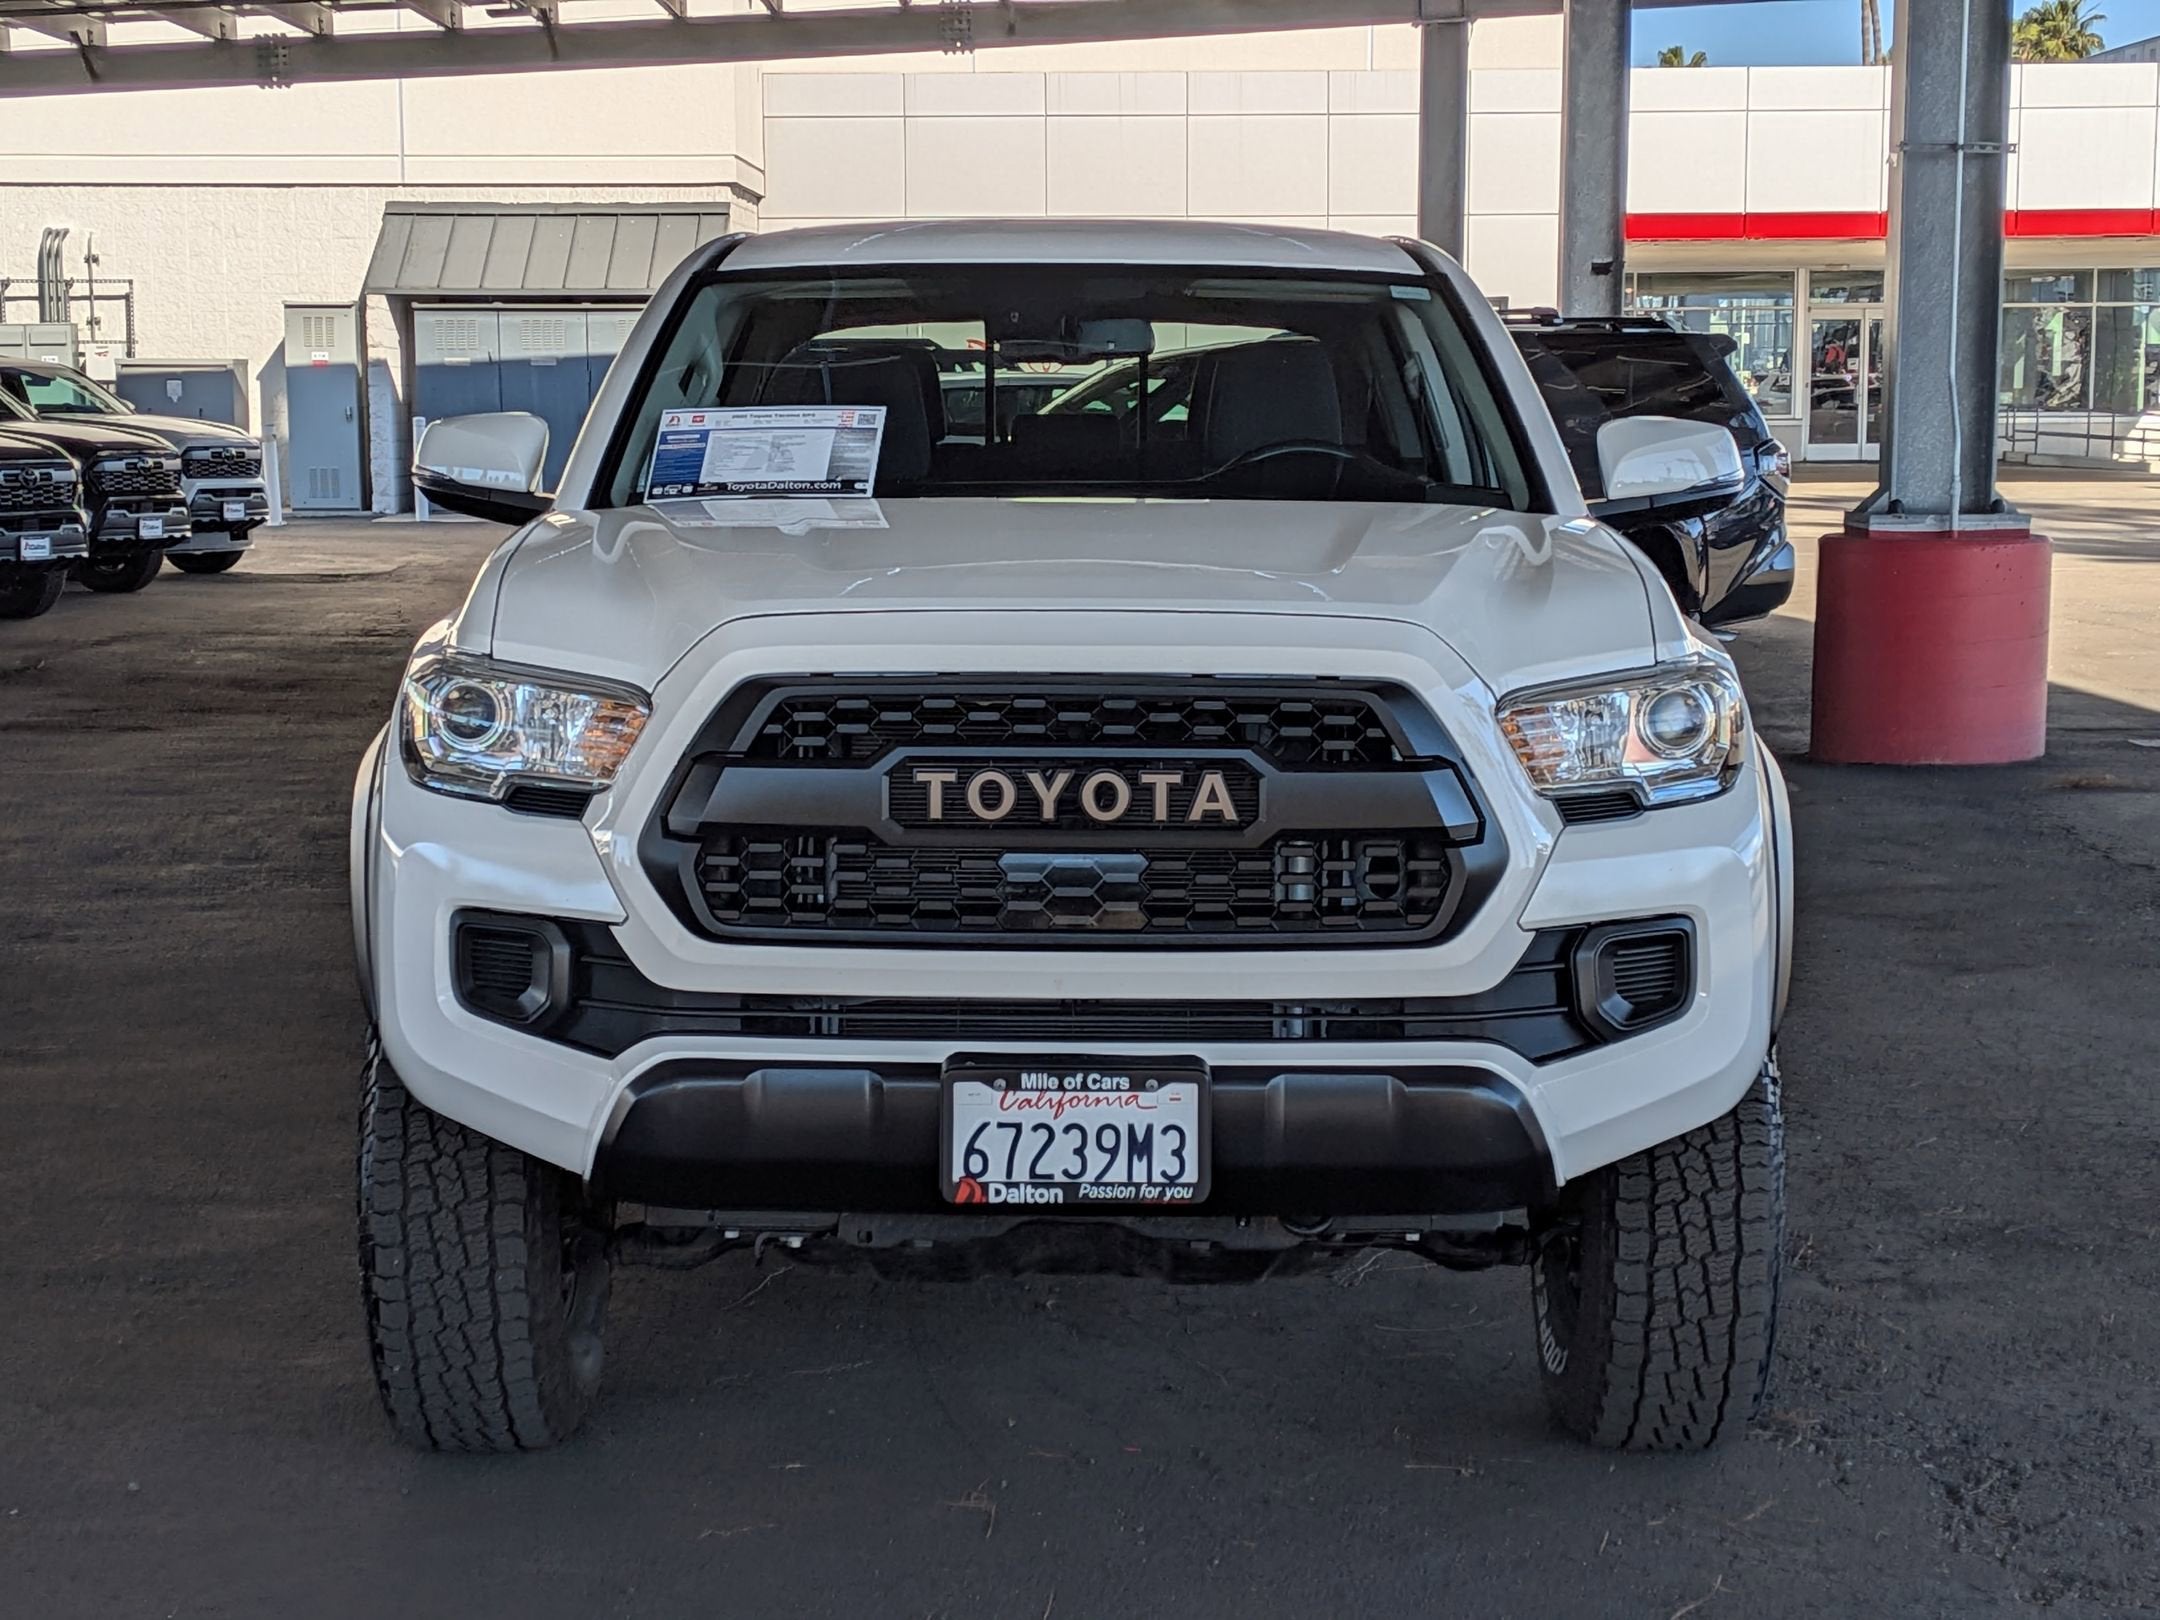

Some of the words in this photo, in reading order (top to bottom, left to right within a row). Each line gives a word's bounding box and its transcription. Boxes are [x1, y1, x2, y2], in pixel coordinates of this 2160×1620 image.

[727, 480, 841, 491] ToyotaDalton.com
[913, 768, 1239, 822] TOYOTA
[1021, 1073, 1059, 1090] Mile
[1063, 1073, 1084, 1090] of
[1086, 1073, 1130, 1090] Cars
[1000, 1088, 1158, 1120] California
[963, 1121, 1187, 1183] 67239M3
[988, 1184, 1063, 1204] Dalton
[1079, 1184, 1136, 1199] Passion
[1139, 1184, 1161, 1199] for
[1164, 1186, 1194, 1201] you
